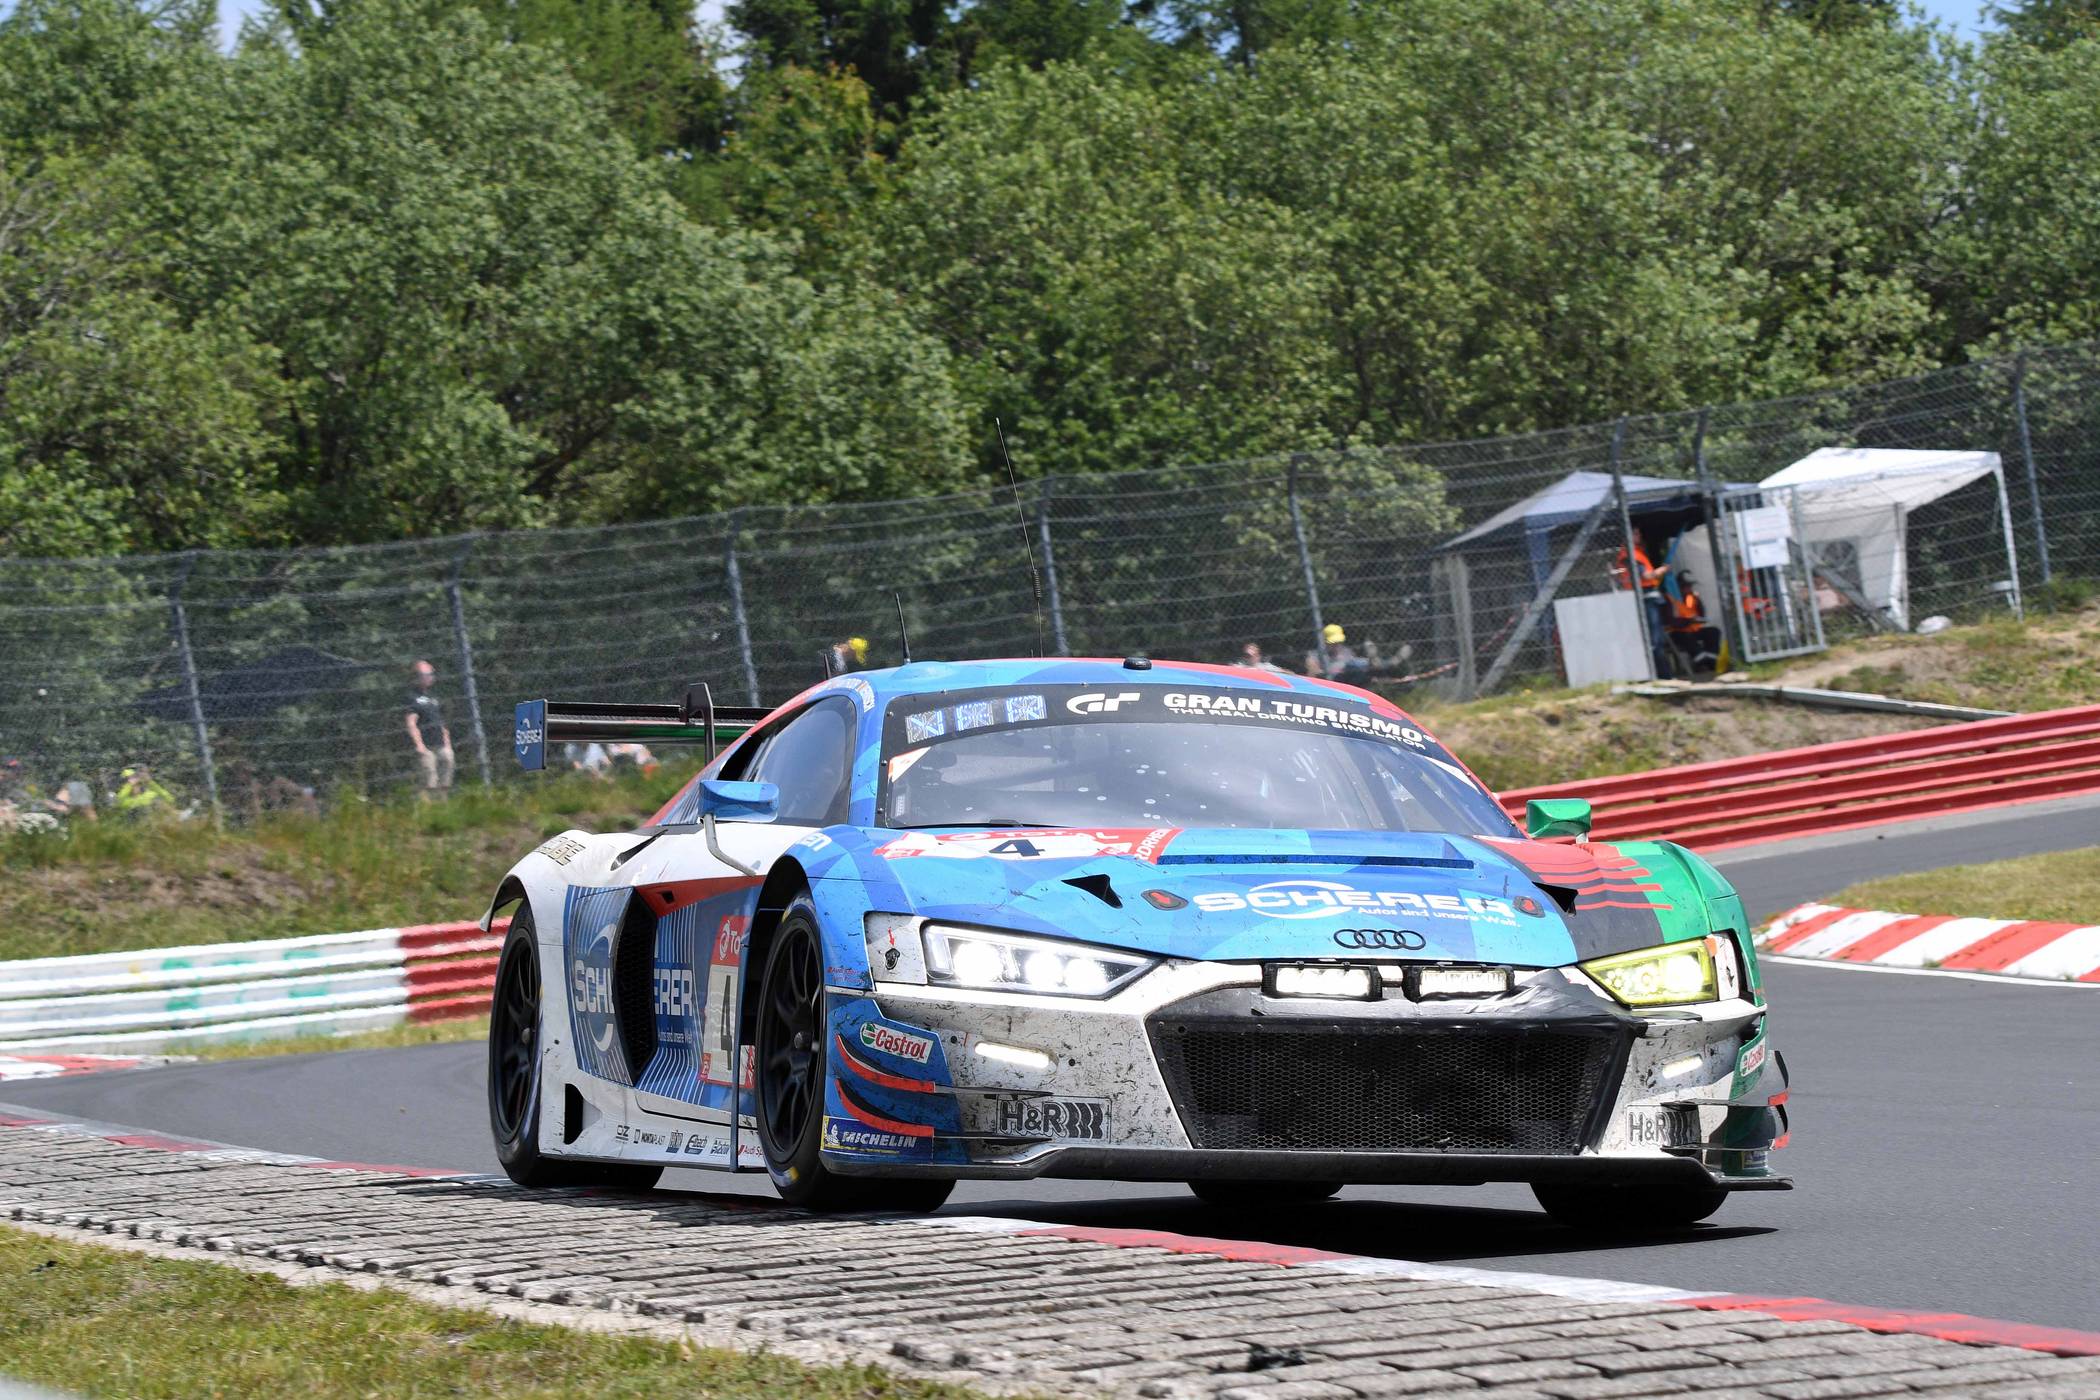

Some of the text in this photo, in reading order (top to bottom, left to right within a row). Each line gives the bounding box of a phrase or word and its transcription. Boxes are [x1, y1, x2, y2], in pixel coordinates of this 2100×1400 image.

[1163, 693, 1261, 713] GRAN
[1169, 707, 1427, 750] THE REAL DRIVING SIMULATOR
[989, 839, 1045, 857] 4
[1193, 891, 1515, 919] SCHERER
[1358, 907, 1398, 916] Autos
[1401, 908, 1430, 918] sind
[1433, 912, 1480, 922] unsere
[721, 975, 733, 1071] 4
[876, 1029, 927, 1060] Castrol
[1002, 1101, 1063, 1133] H&R
[1629, 1111, 1667, 1143] H&R
[841, 1131, 917, 1148] MICHELIN
